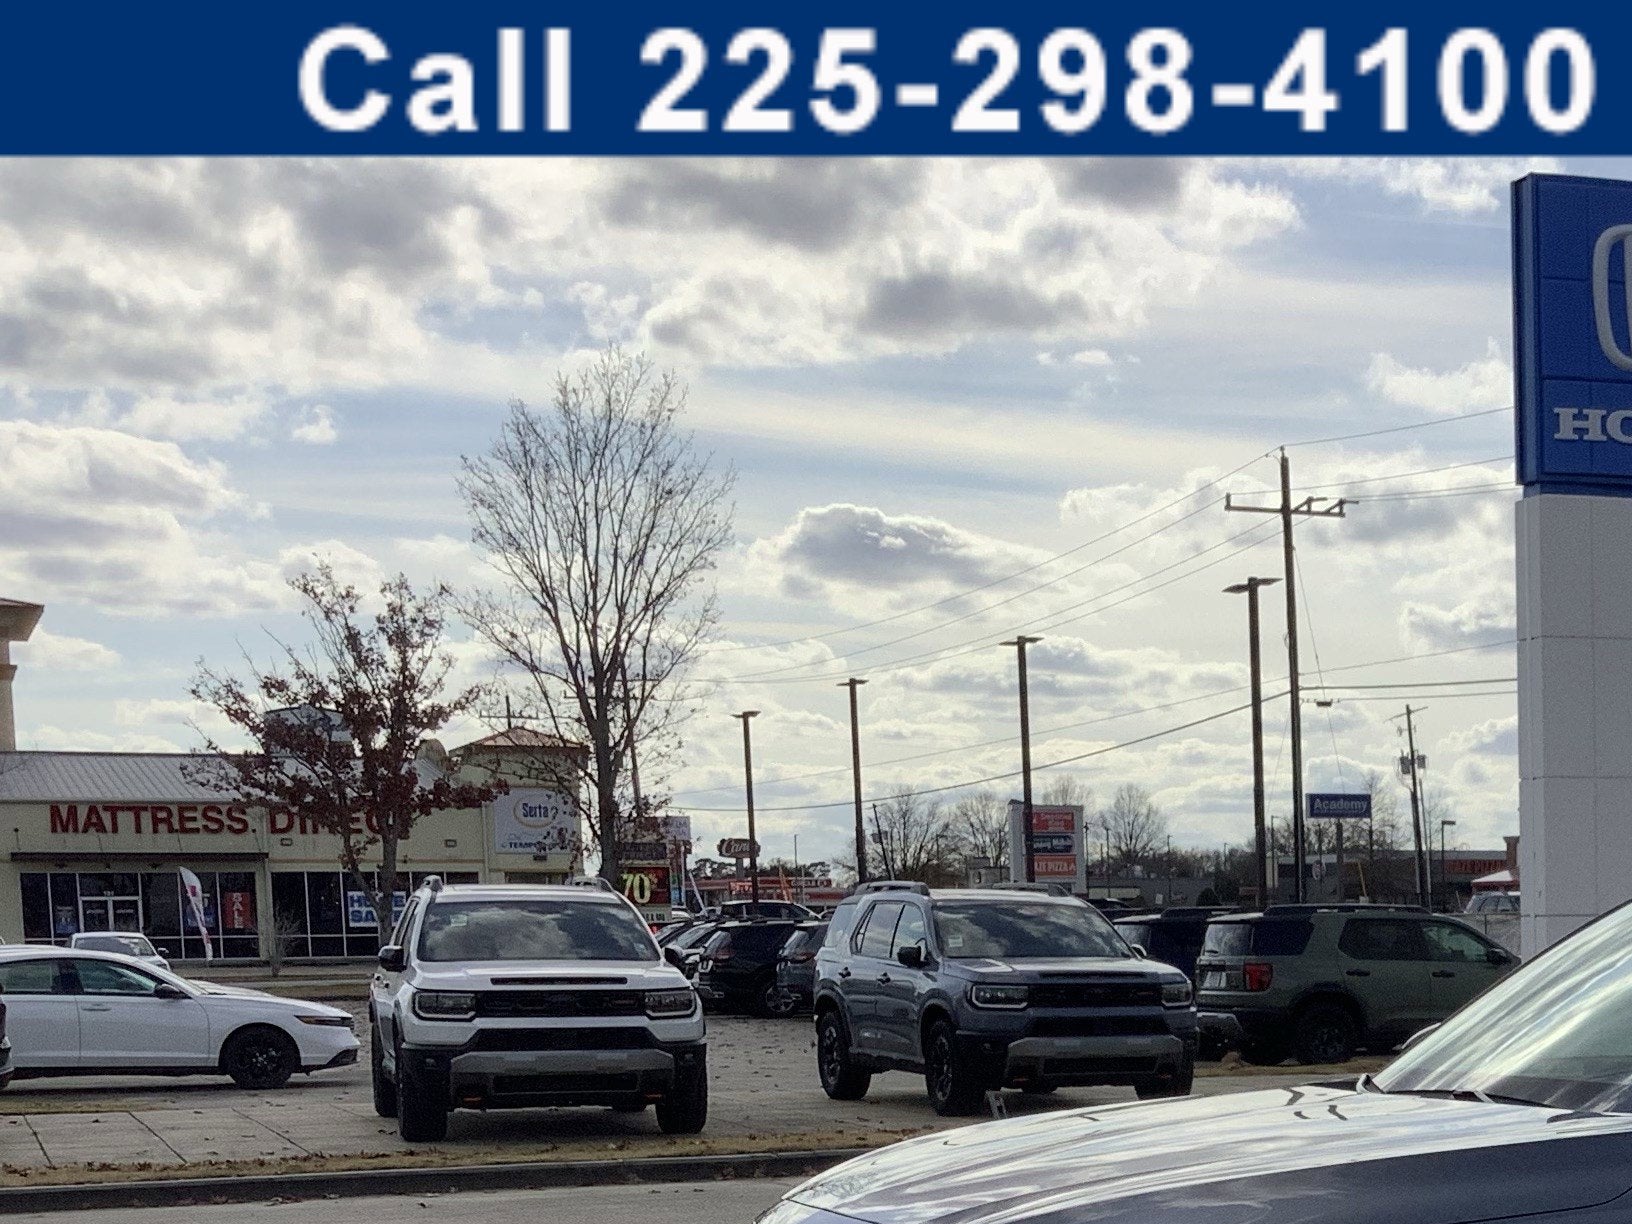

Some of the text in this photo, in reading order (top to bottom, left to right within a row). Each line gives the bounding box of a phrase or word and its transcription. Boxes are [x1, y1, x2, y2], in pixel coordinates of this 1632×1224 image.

[521, 803, 549, 818] Serta
[1314, 798, 1368, 814] Academy
[50, 804, 250, 835] MATTRESS
